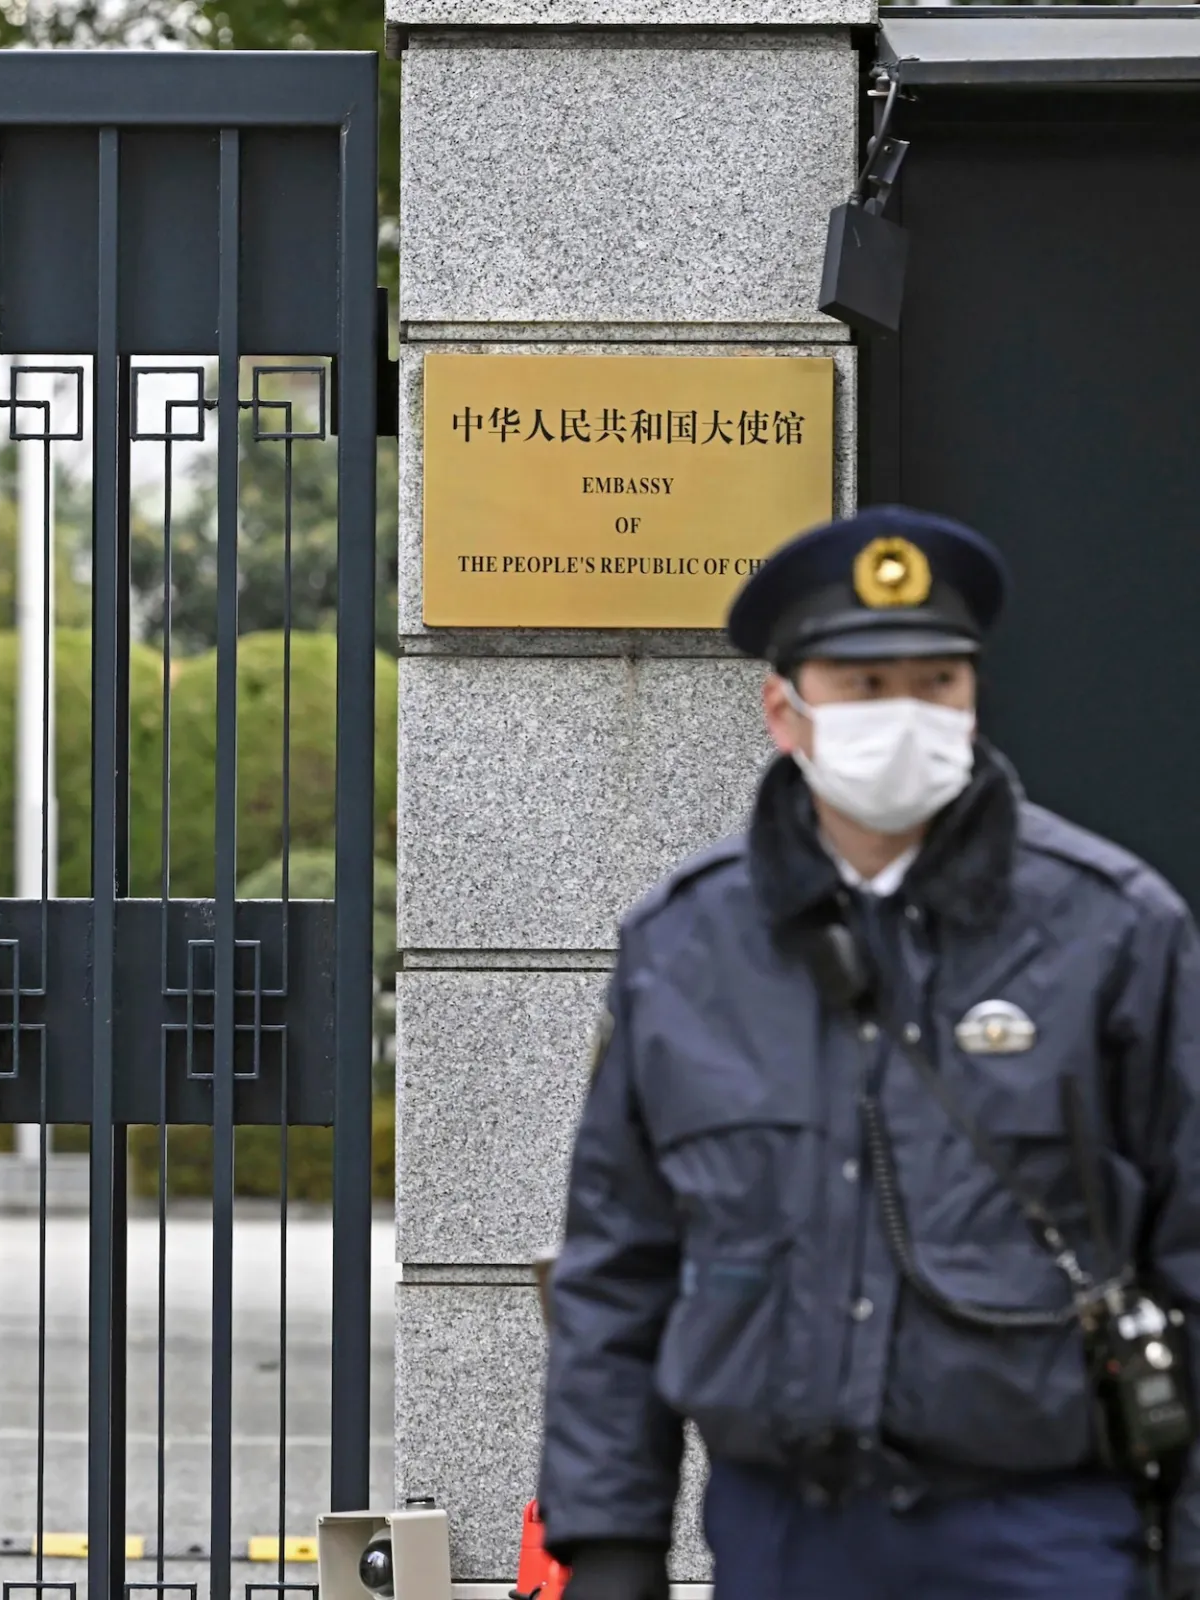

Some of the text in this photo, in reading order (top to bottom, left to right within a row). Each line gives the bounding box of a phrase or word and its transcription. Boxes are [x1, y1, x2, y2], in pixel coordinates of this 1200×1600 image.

[452, 406, 806, 446] 中华人民共和国大使馆
[582, 476, 675, 495] EMBASSY
[614, 516, 642, 534] OF
[457, 555, 768, 576] THE PEOPLE'S REPUBLIC OF CH
